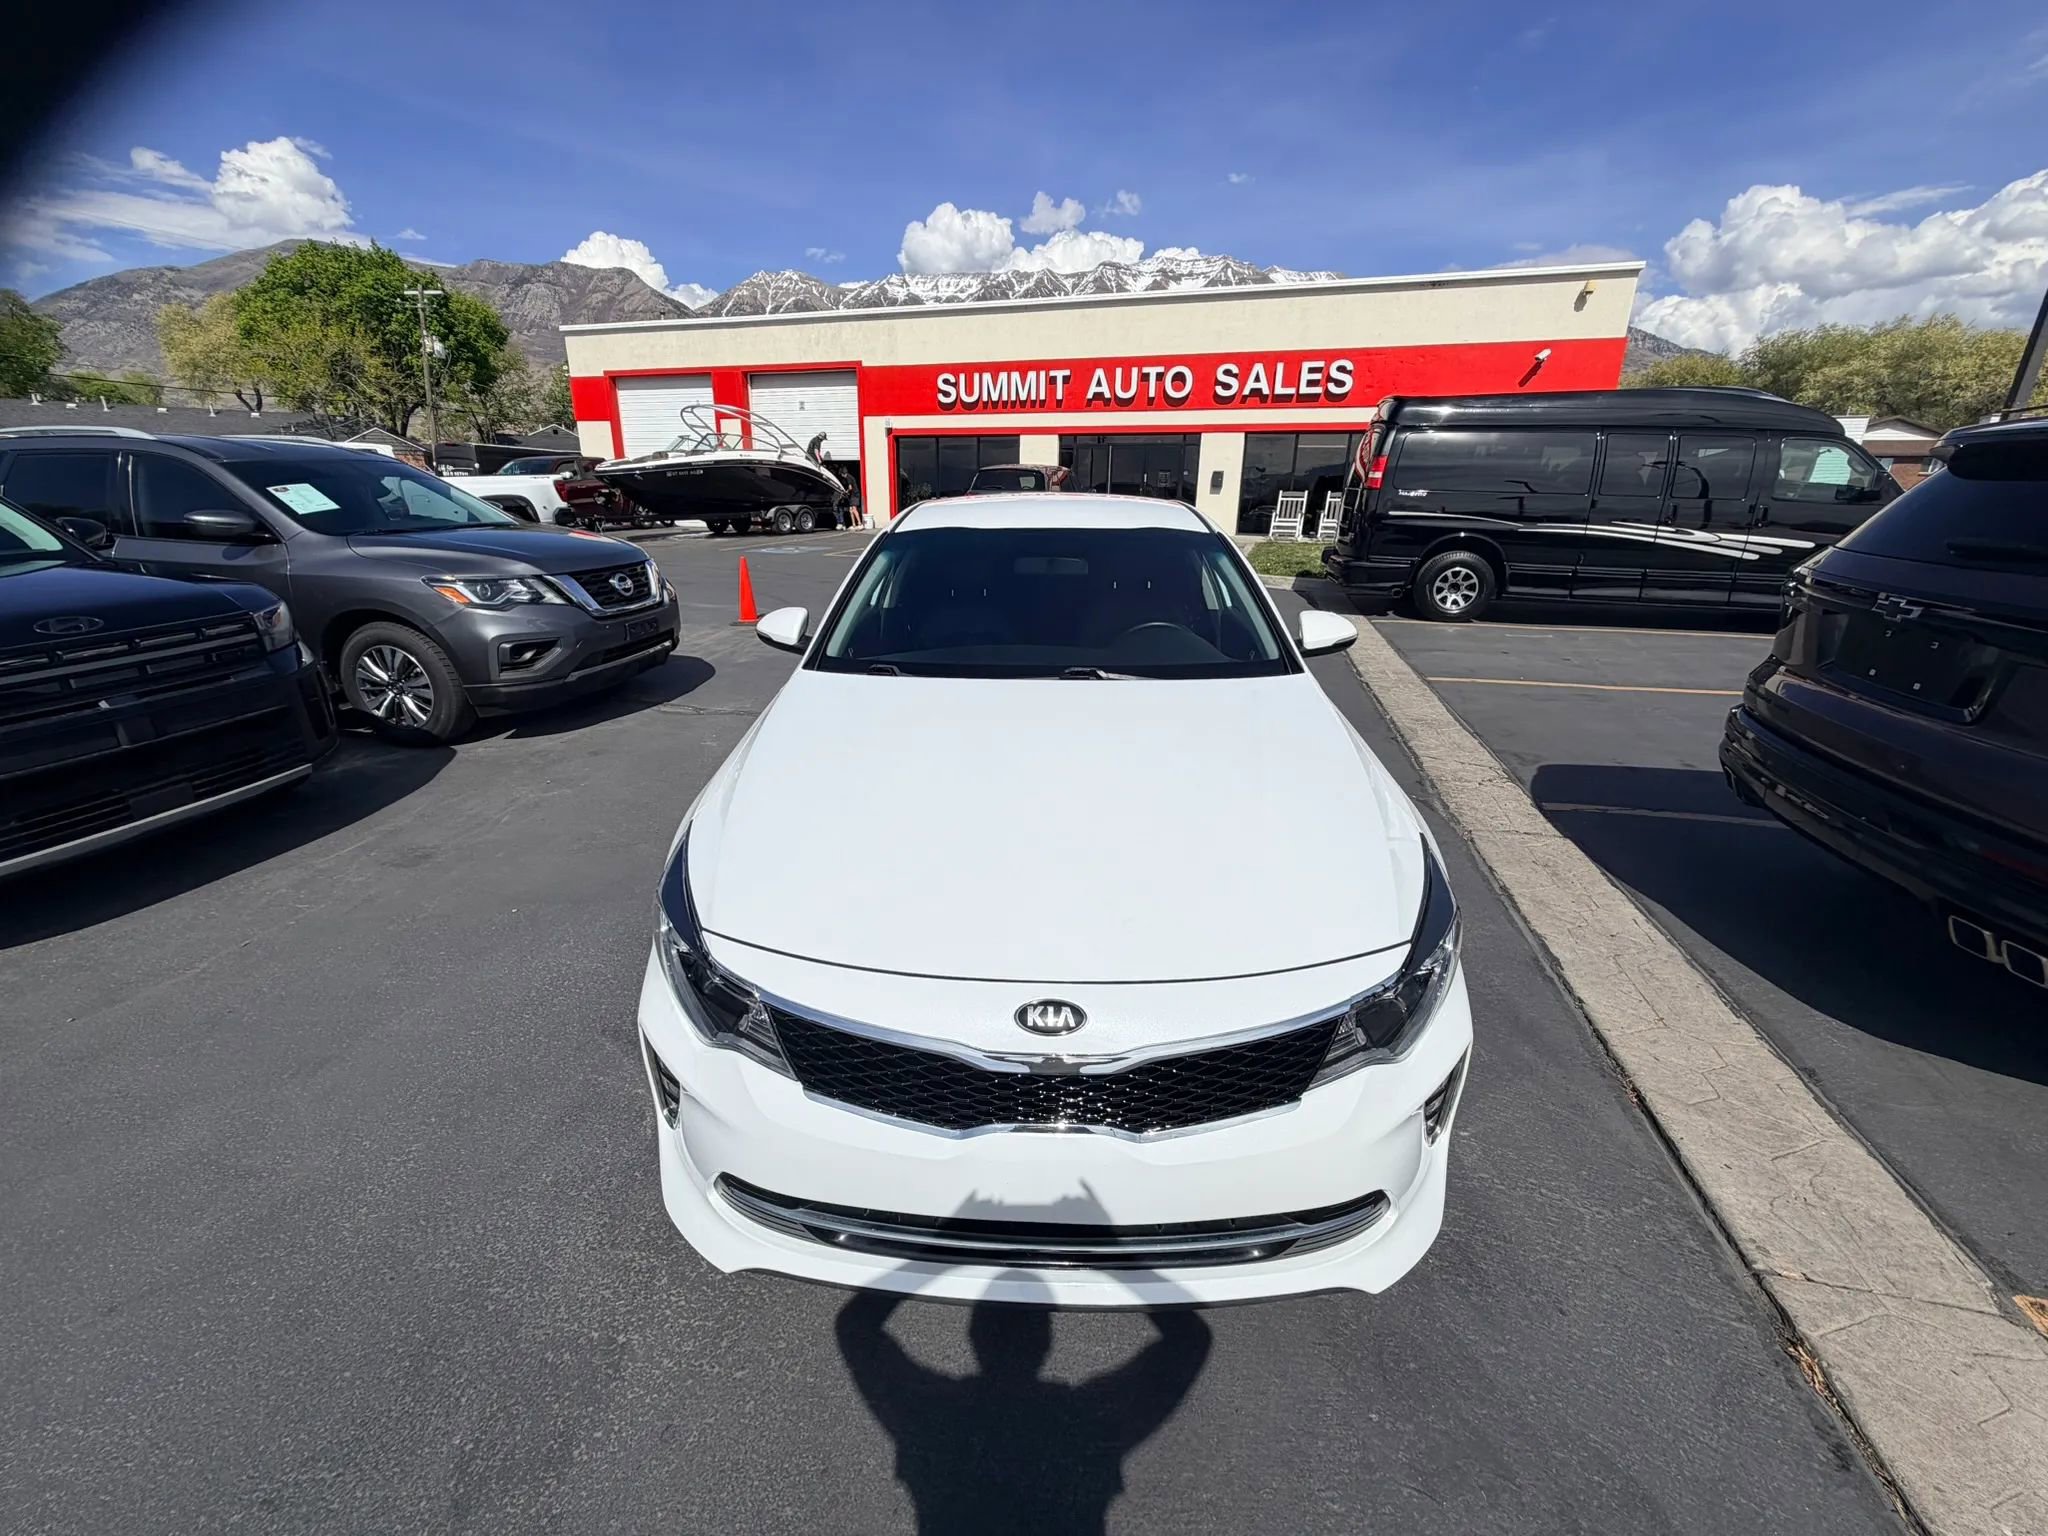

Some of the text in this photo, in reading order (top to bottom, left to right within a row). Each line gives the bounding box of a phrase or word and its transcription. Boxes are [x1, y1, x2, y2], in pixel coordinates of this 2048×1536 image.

[936, 359, 1355, 404] SUMMIT AUTO SALES
[1026, 1005, 1077, 1028] KIA
